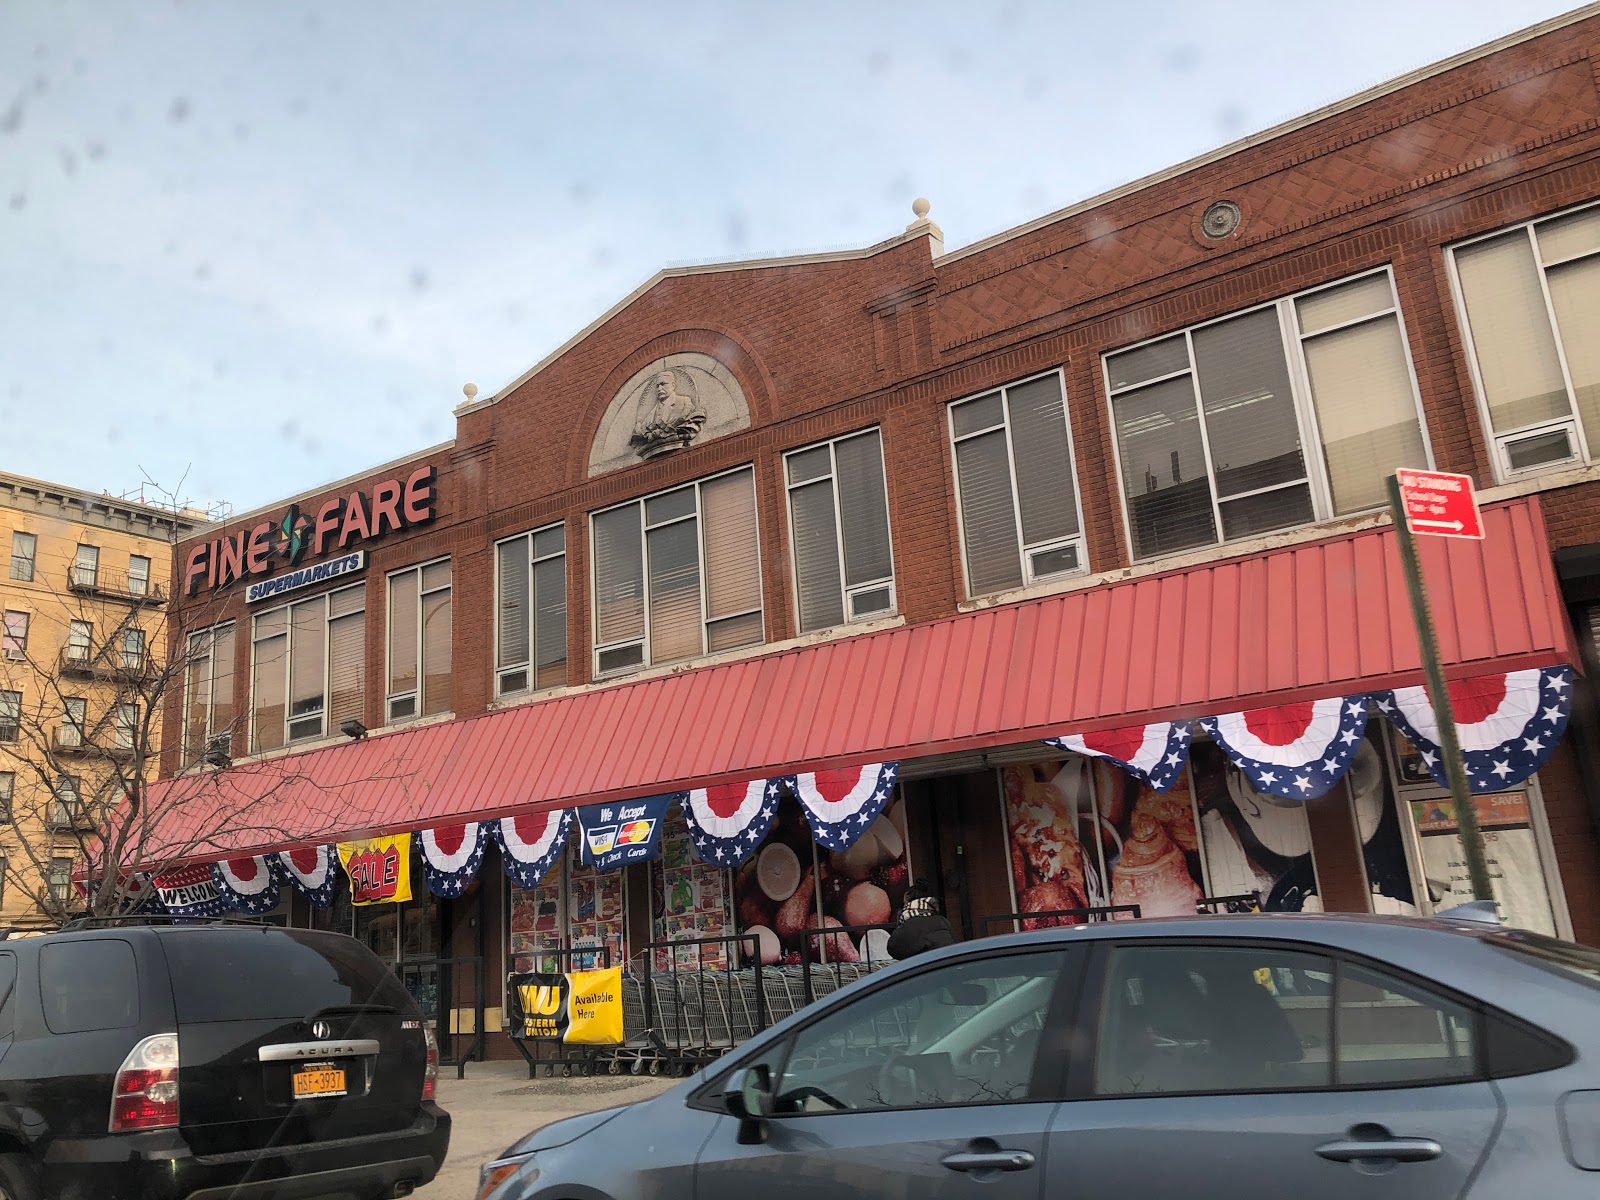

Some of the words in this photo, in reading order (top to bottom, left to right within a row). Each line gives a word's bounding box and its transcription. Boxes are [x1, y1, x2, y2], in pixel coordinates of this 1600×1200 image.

[184, 521, 271, 595] FINE
[315, 465, 432, 555] FARE
[249, 553, 360, 600] SUPERMARKETS
[600, 807, 613, 823] We
[618, 804, 647, 821] Accept
[594, 834, 608, 846] VISA
[627, 847, 648, 858] Cards
[350, 854, 398, 891] SALE
[162, 881, 219, 905] WELCOM
[517, 985, 561, 1016] WU
[574, 992, 614, 1006] Available
[577, 1009, 595, 1020] Here
[525, 1027, 558, 1037] UNION
[296, 1046, 354, 1056] ACURA
